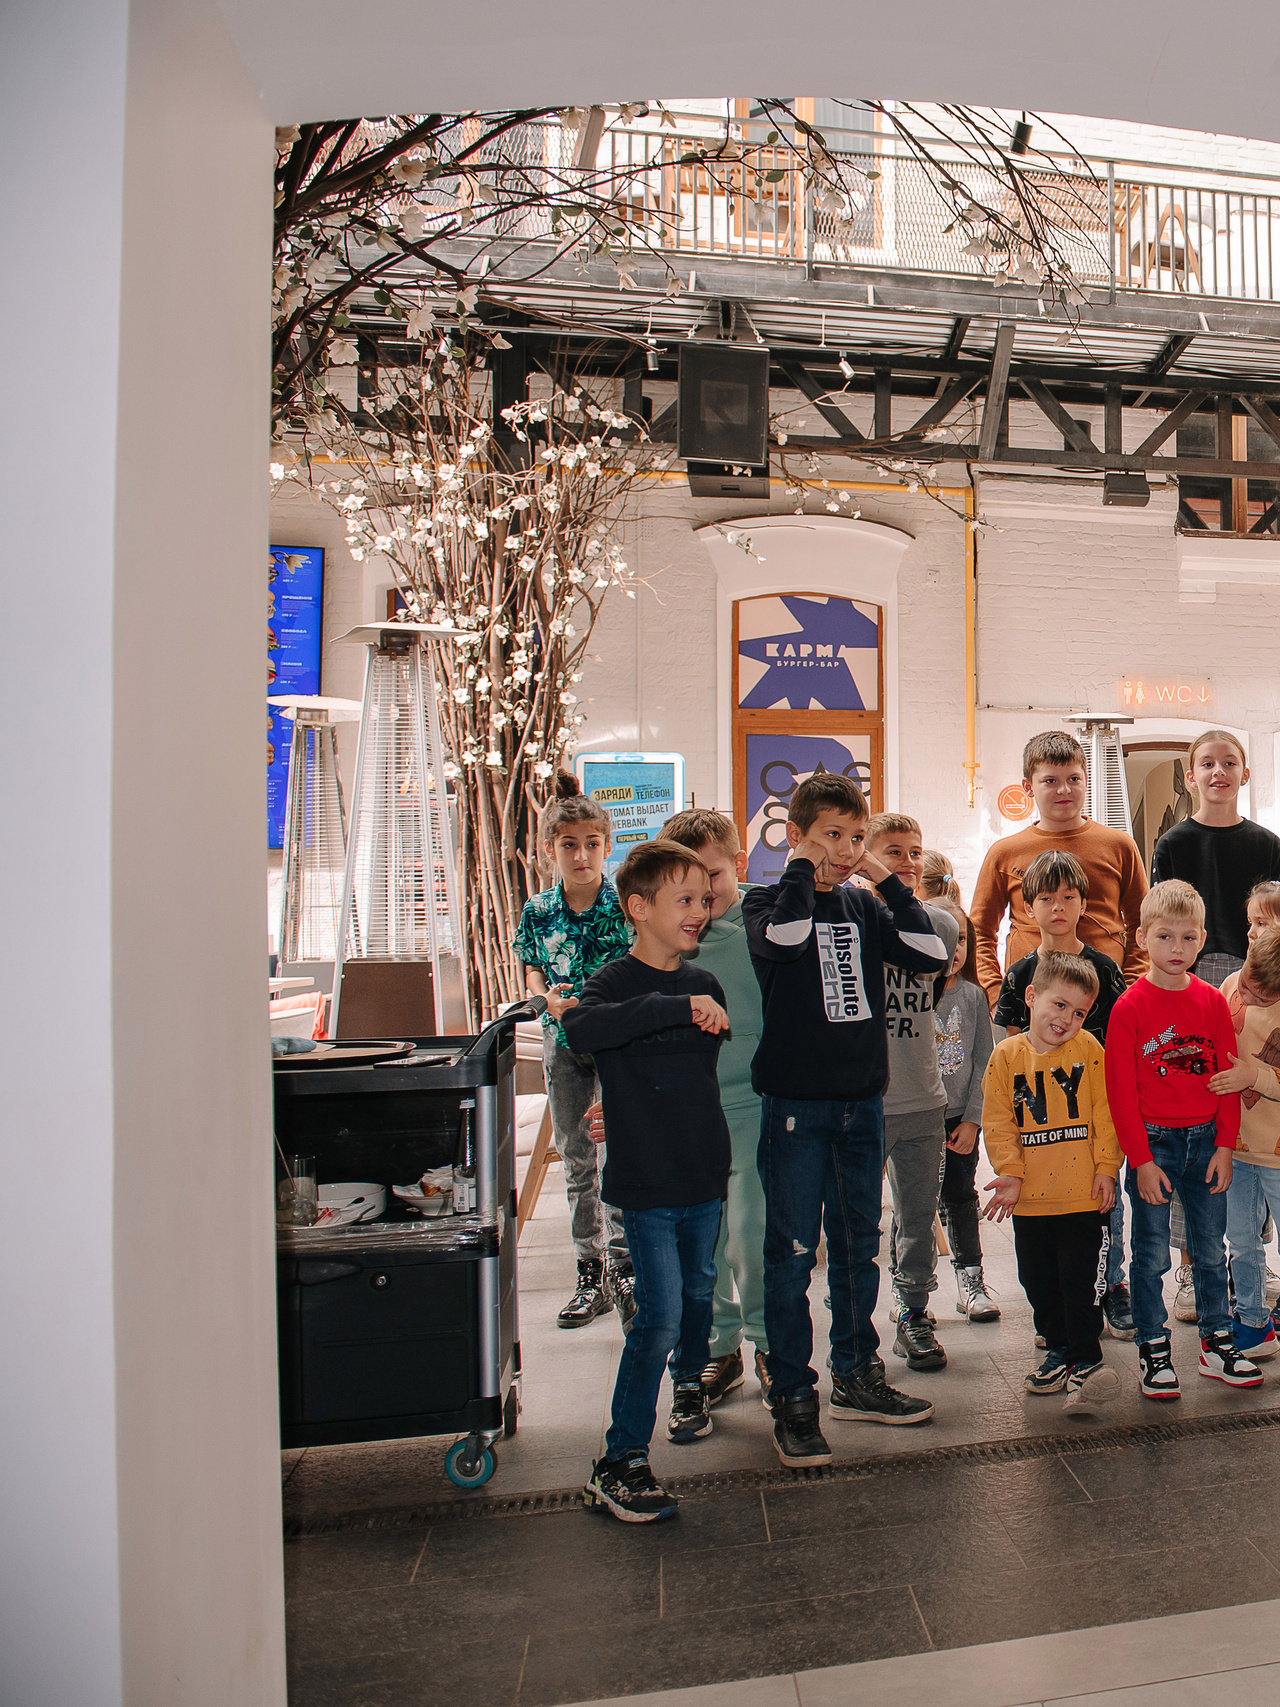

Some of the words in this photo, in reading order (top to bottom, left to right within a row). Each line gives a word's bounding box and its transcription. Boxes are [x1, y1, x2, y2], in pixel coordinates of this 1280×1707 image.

[776, 660, 840, 668] БУРГЕР-БАР
[1155, 685, 1192, 703] WC
[594, 787, 632, 801] ЗАРЯДИ
[636, 788, 671, 800] ТЕЛЕФОН
[609, 807, 635, 818] ТОМАТ
[637, 803, 669, 815] ВЫДАЕТ
[832, 925, 860, 1017] Absolute
[886, 991, 932, 1013] ARD
[1172, 1034, 1206, 1047] RACING
[1012, 1062, 1085, 1127] NY
[1048, 1130, 1063, 1142] OF
[1064, 1126, 1088, 1139] MIND
